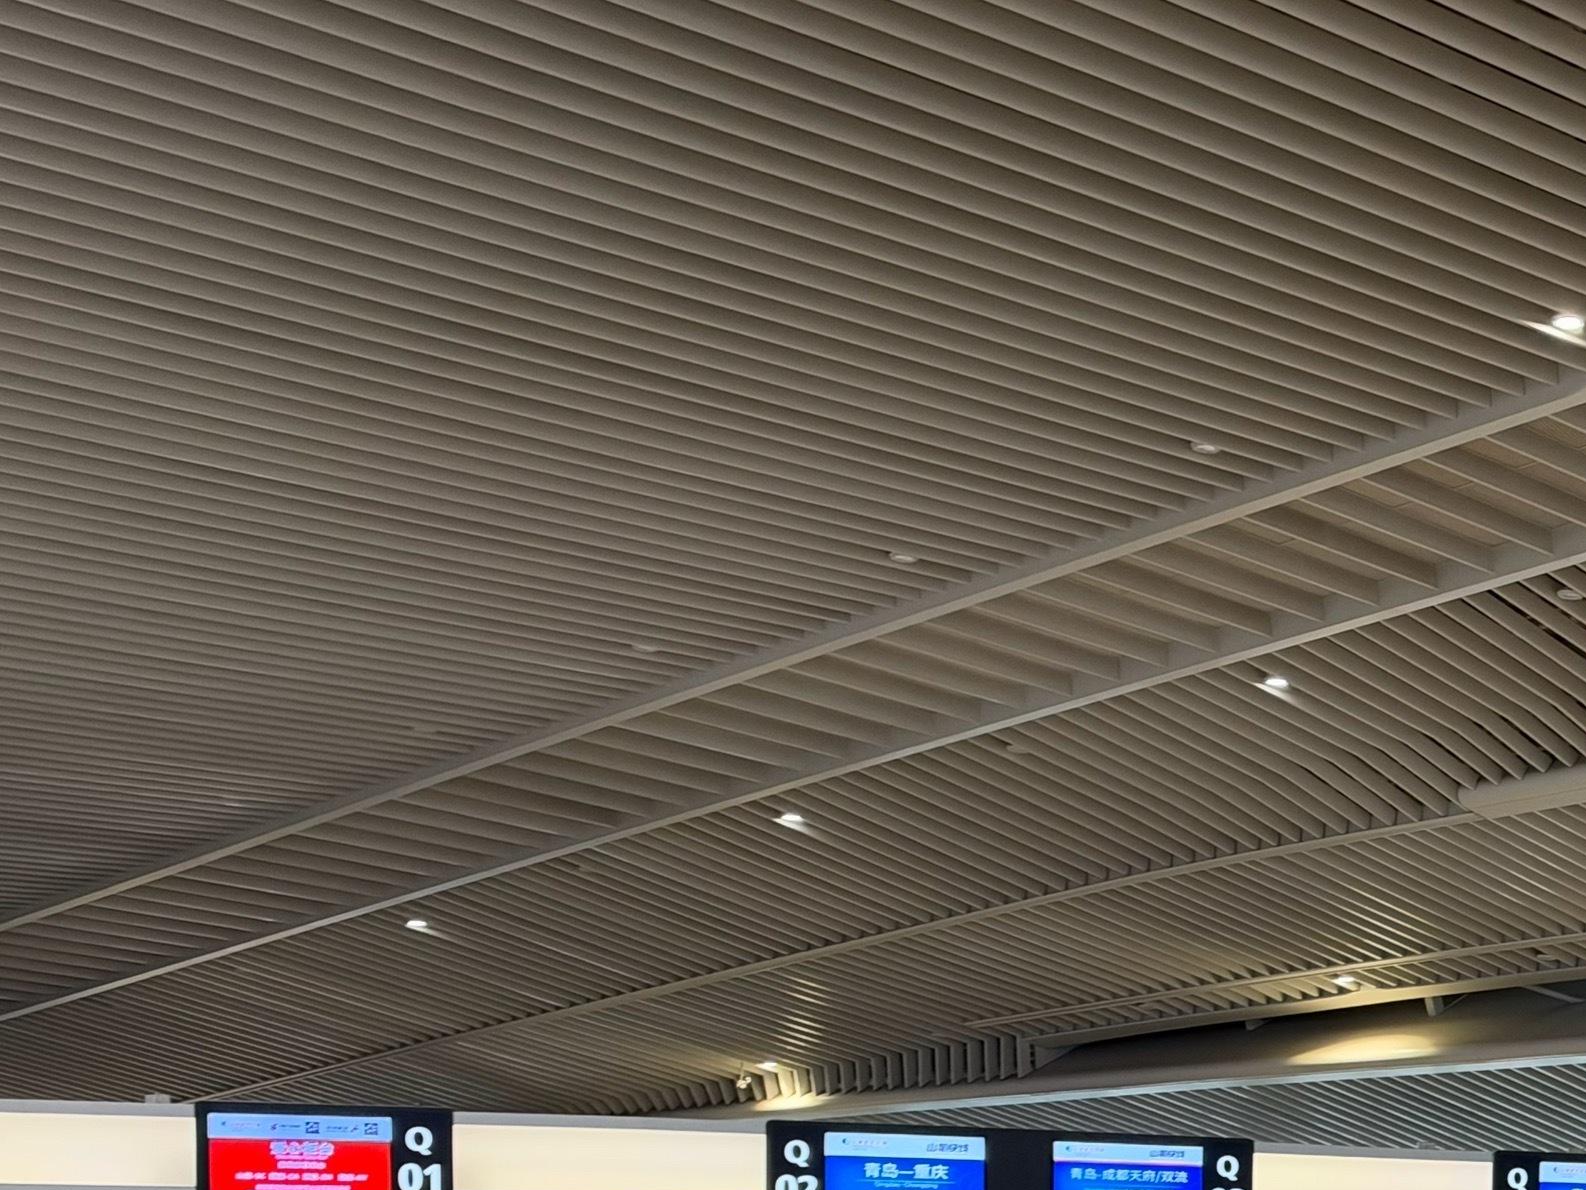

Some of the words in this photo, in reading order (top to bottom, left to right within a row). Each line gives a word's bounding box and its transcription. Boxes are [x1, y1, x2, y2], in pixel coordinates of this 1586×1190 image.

[404, 1126, 434, 1155] Q
[784, 1139, 811, 1167] Q
[1216, 1155, 1240, 1181] Q
